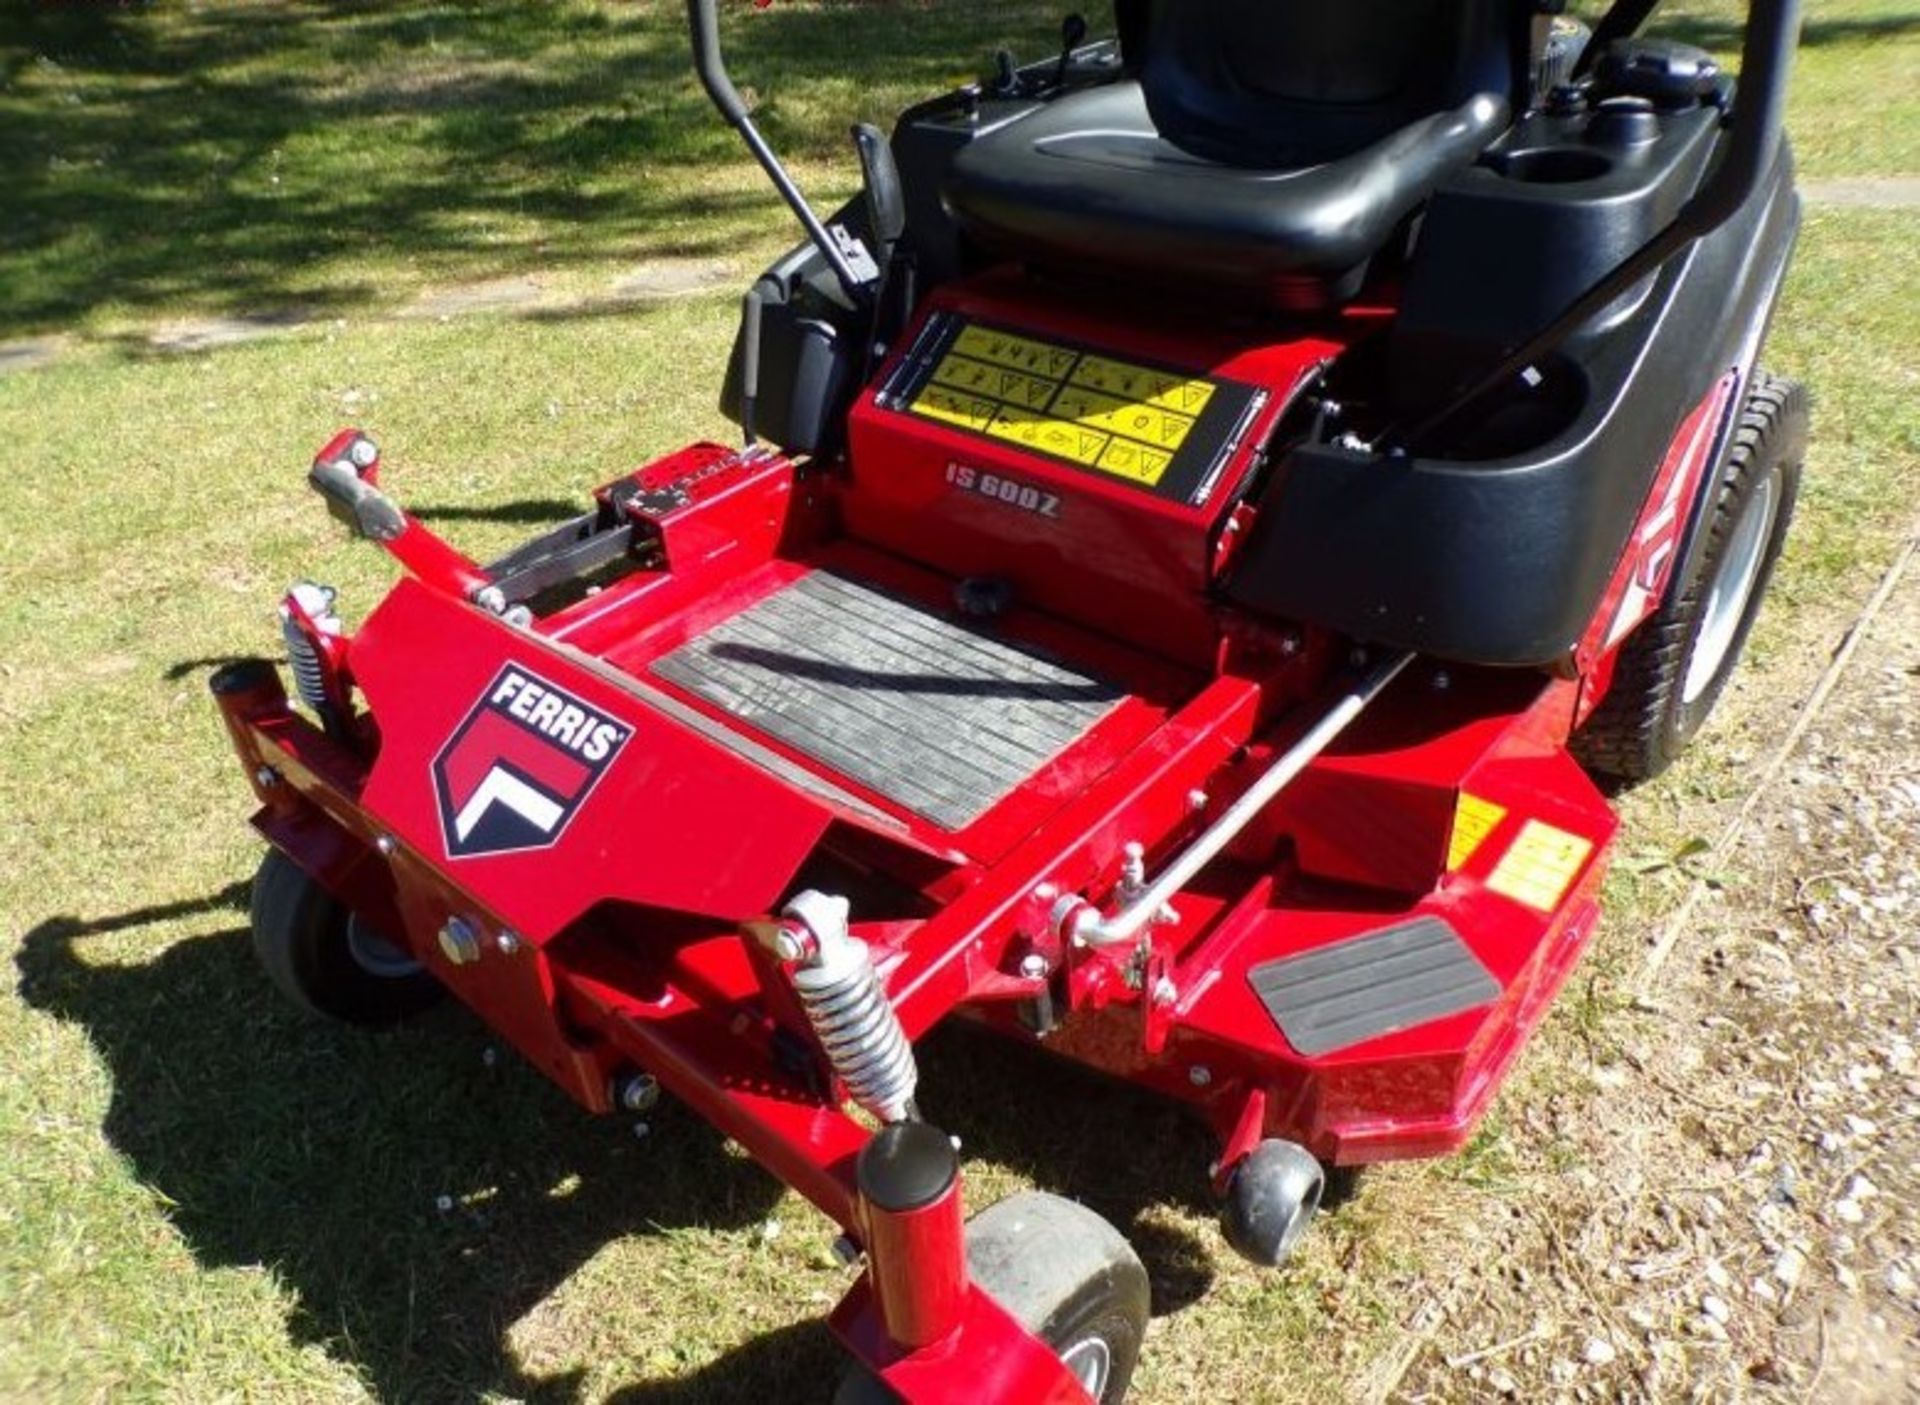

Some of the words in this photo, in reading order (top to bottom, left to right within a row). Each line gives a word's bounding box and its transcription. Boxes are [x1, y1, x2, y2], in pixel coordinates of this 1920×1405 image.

[945, 462, 976, 489] IS
[979, 473, 1060, 519] 600Z
[490, 671, 619, 762] FERRIS
